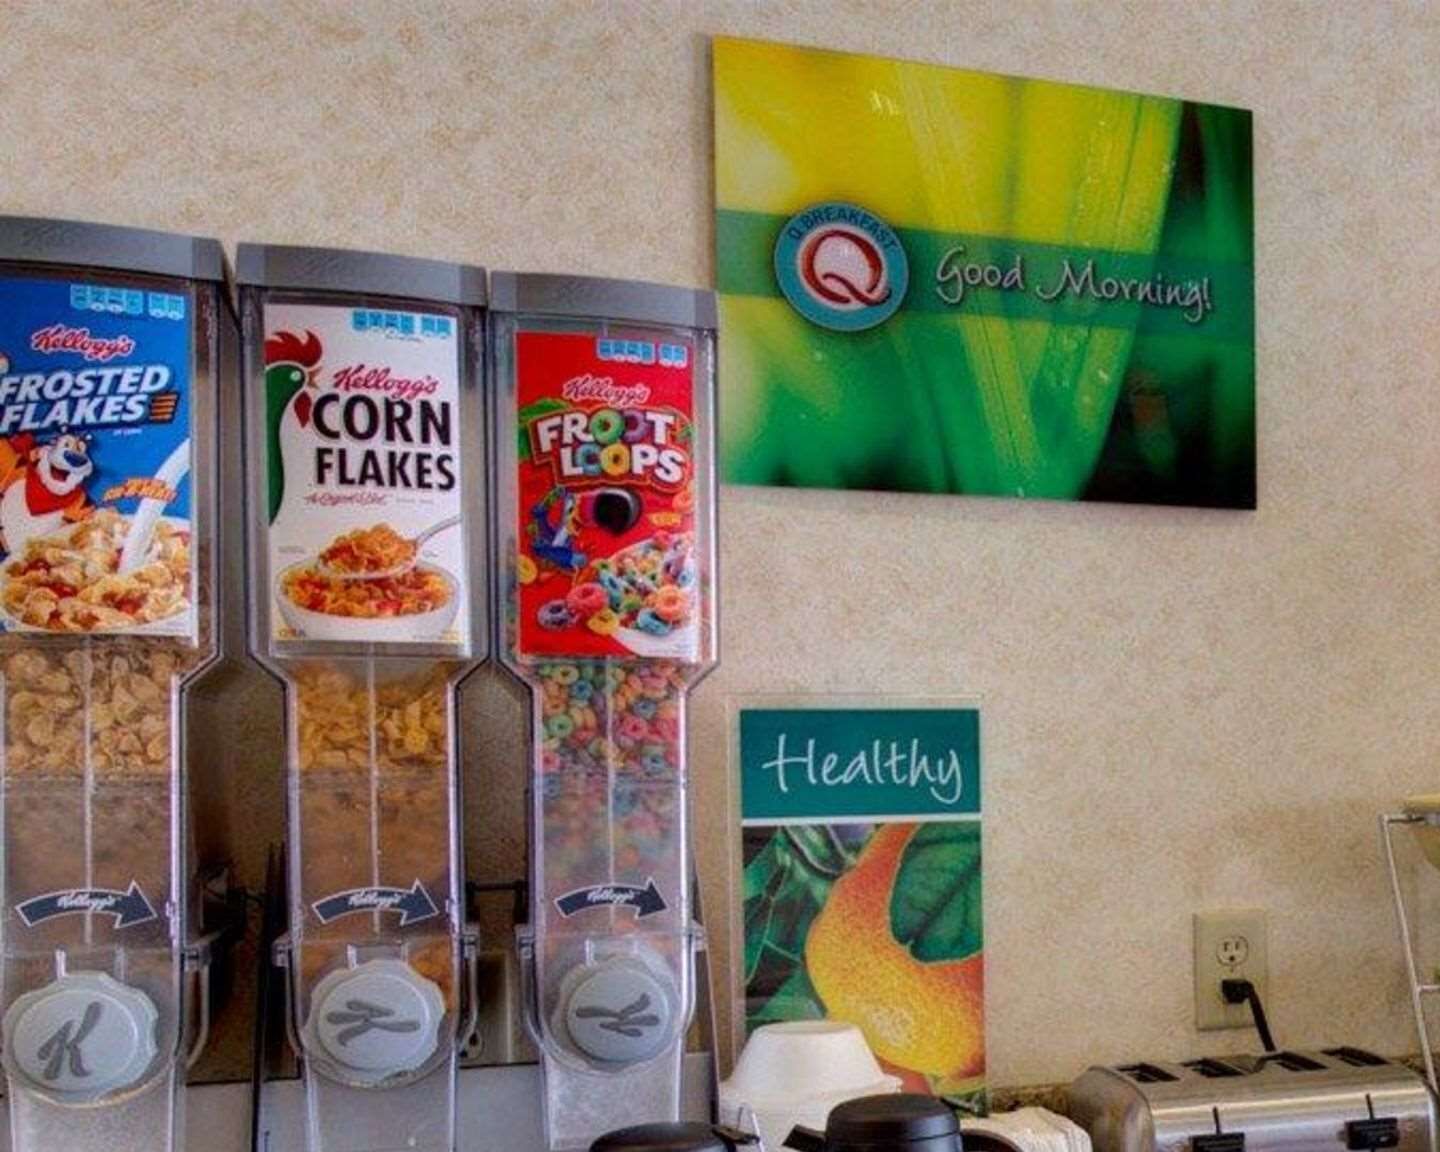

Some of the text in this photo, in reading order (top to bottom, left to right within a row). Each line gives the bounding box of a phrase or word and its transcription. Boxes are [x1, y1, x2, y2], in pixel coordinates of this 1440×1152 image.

[804, 204, 898, 249] BREAKFAST
[800, 229, 893, 308] Q
[935, 246, 1213, 323] Good Morning!
[32, 325, 135, 360] Kellogg's
[0, 364, 171, 405] FROSTED
[333, 363, 441, 400] Kellogg's
[563, 375, 650, 407] Kellogg's
[0, 393, 149, 436] FLAKES
[312, 393, 452, 447] CORN
[536, 408, 676, 453] FROOT
[315, 446, 457, 492] FLAKES
[559, 443, 685, 483] LOOPS
[761, 732, 963, 805] Healthy
